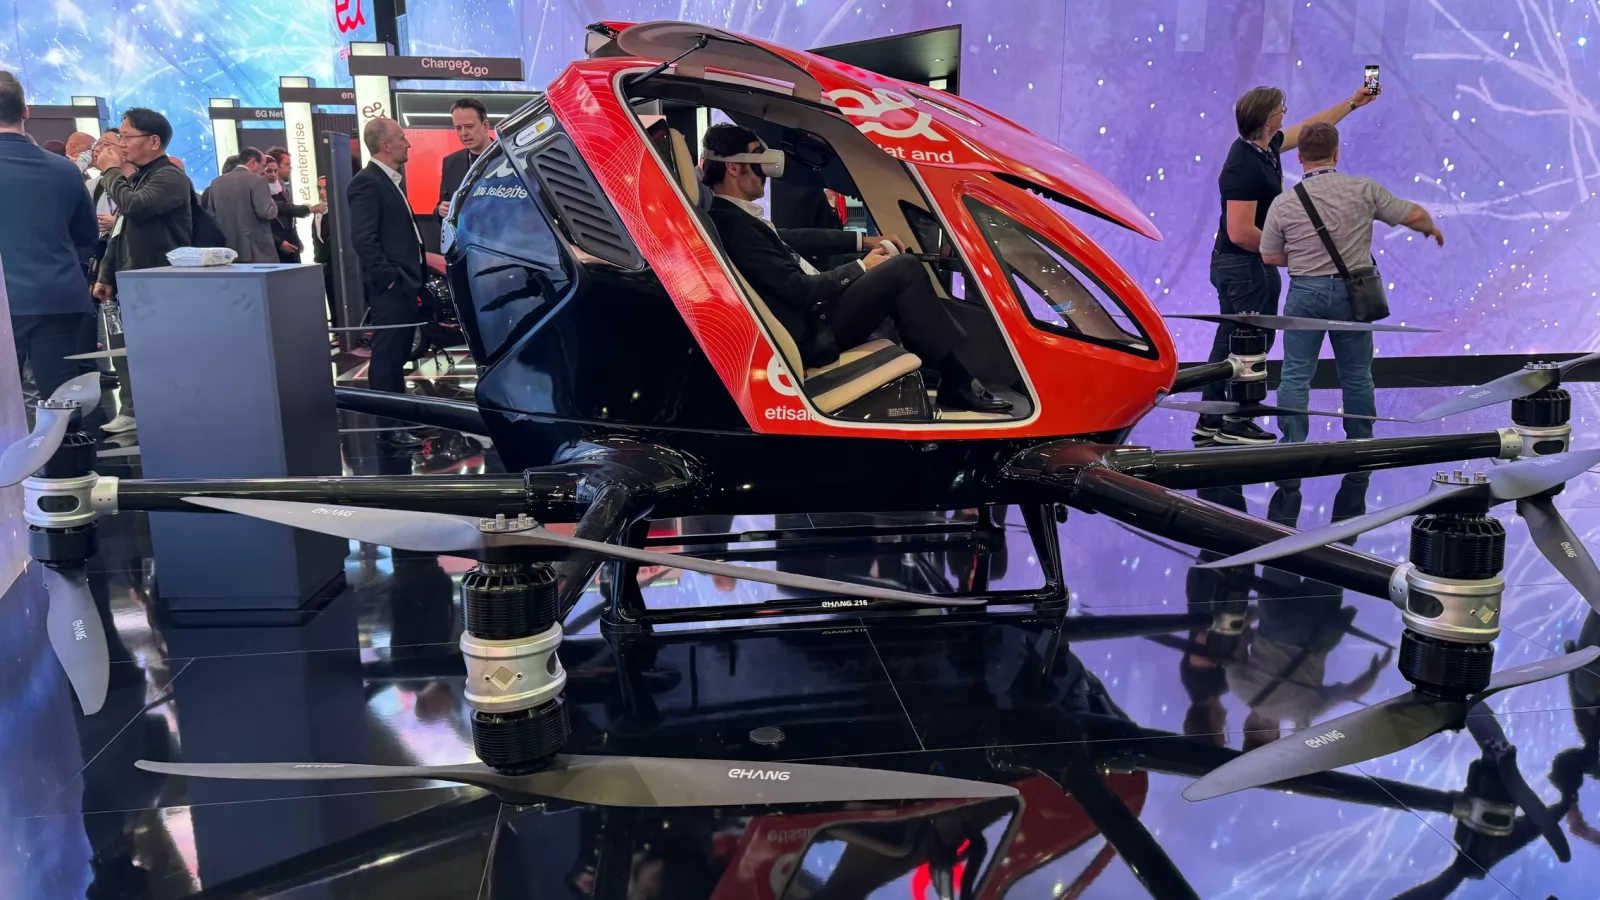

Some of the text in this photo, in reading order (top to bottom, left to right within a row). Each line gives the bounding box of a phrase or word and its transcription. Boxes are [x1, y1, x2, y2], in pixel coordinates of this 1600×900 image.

[421, 58, 489, 77] Charge&go
[341, 92, 355, 101] en
[255, 110, 268, 118] 5G
[294, 122, 310, 184] enterprise
[911, 150, 954, 163] and
